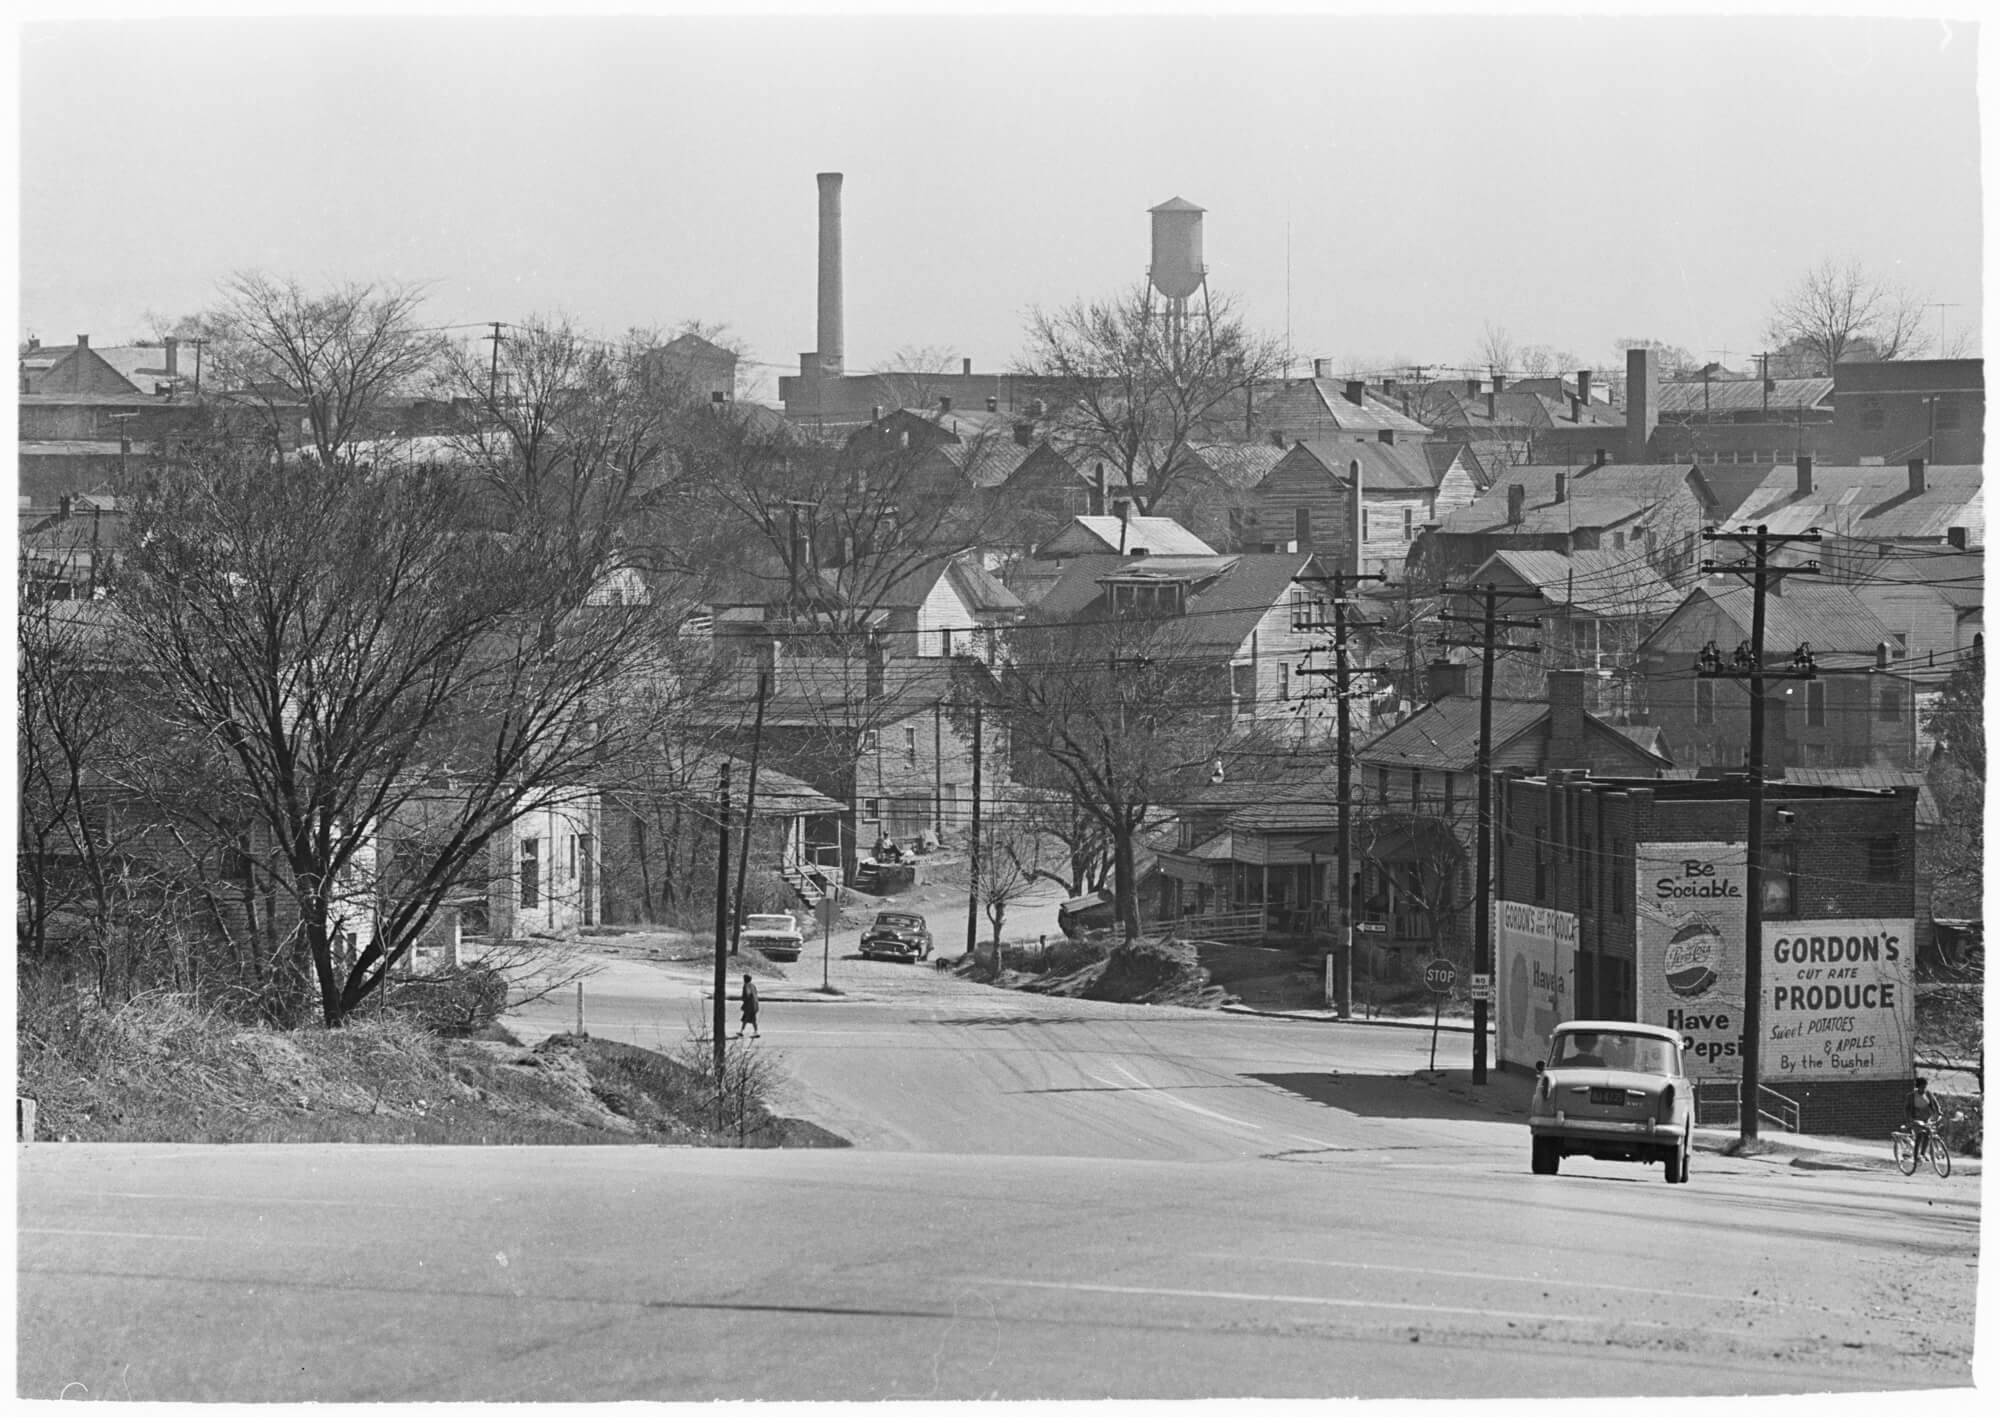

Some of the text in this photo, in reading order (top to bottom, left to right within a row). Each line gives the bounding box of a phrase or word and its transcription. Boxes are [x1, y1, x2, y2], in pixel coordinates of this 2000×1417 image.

[1681, 860, 1715, 877] Be
[1656, 878, 1742, 898] Sociable
[1505, 903, 1535, 934] GORDON'S
[1774, 932, 1900, 964] GORDON'S
[1427, 969, 1455, 983] STOP
[1797, 967, 1859, 980] CUT RATE
[1558, 976, 1565, 993] a
[1774, 983, 1895, 1011] PRODUCE
[1667, 1009, 1729, 1030] Have
[1769, 1016, 1856, 1040] Sweet POTATOES
[1823, 1035, 1876, 1056] & APPLES
[1780, 1052, 1875, 1073] By the Bushel
